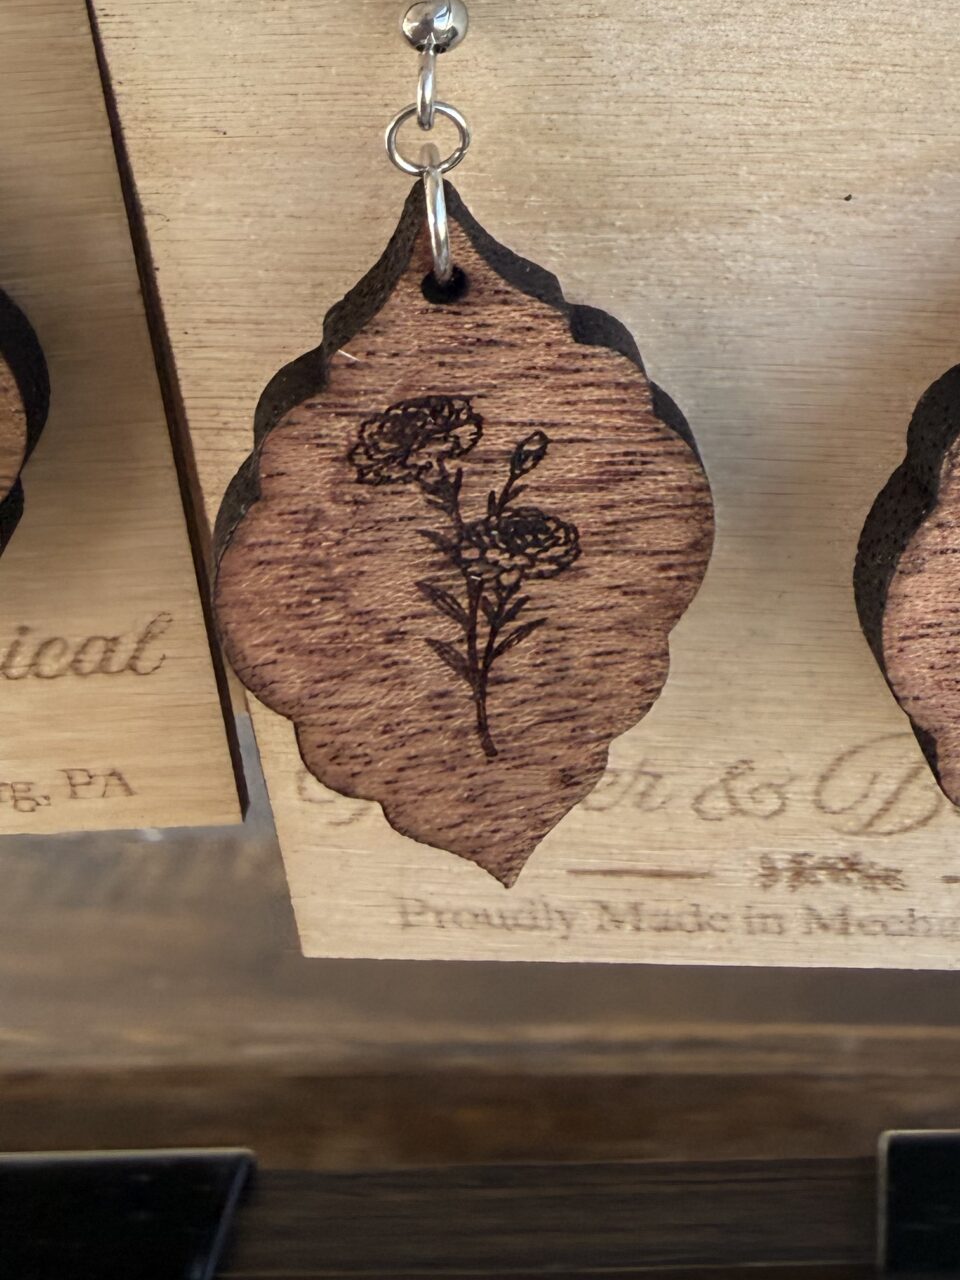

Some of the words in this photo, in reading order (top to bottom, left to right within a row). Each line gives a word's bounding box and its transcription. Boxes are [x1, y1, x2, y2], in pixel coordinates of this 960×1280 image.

[58, 768, 138, 799] PA
[396, 894, 576, 940] Proudly
[592, 900, 728, 934] Made
[742, 906, 785, 936] in
